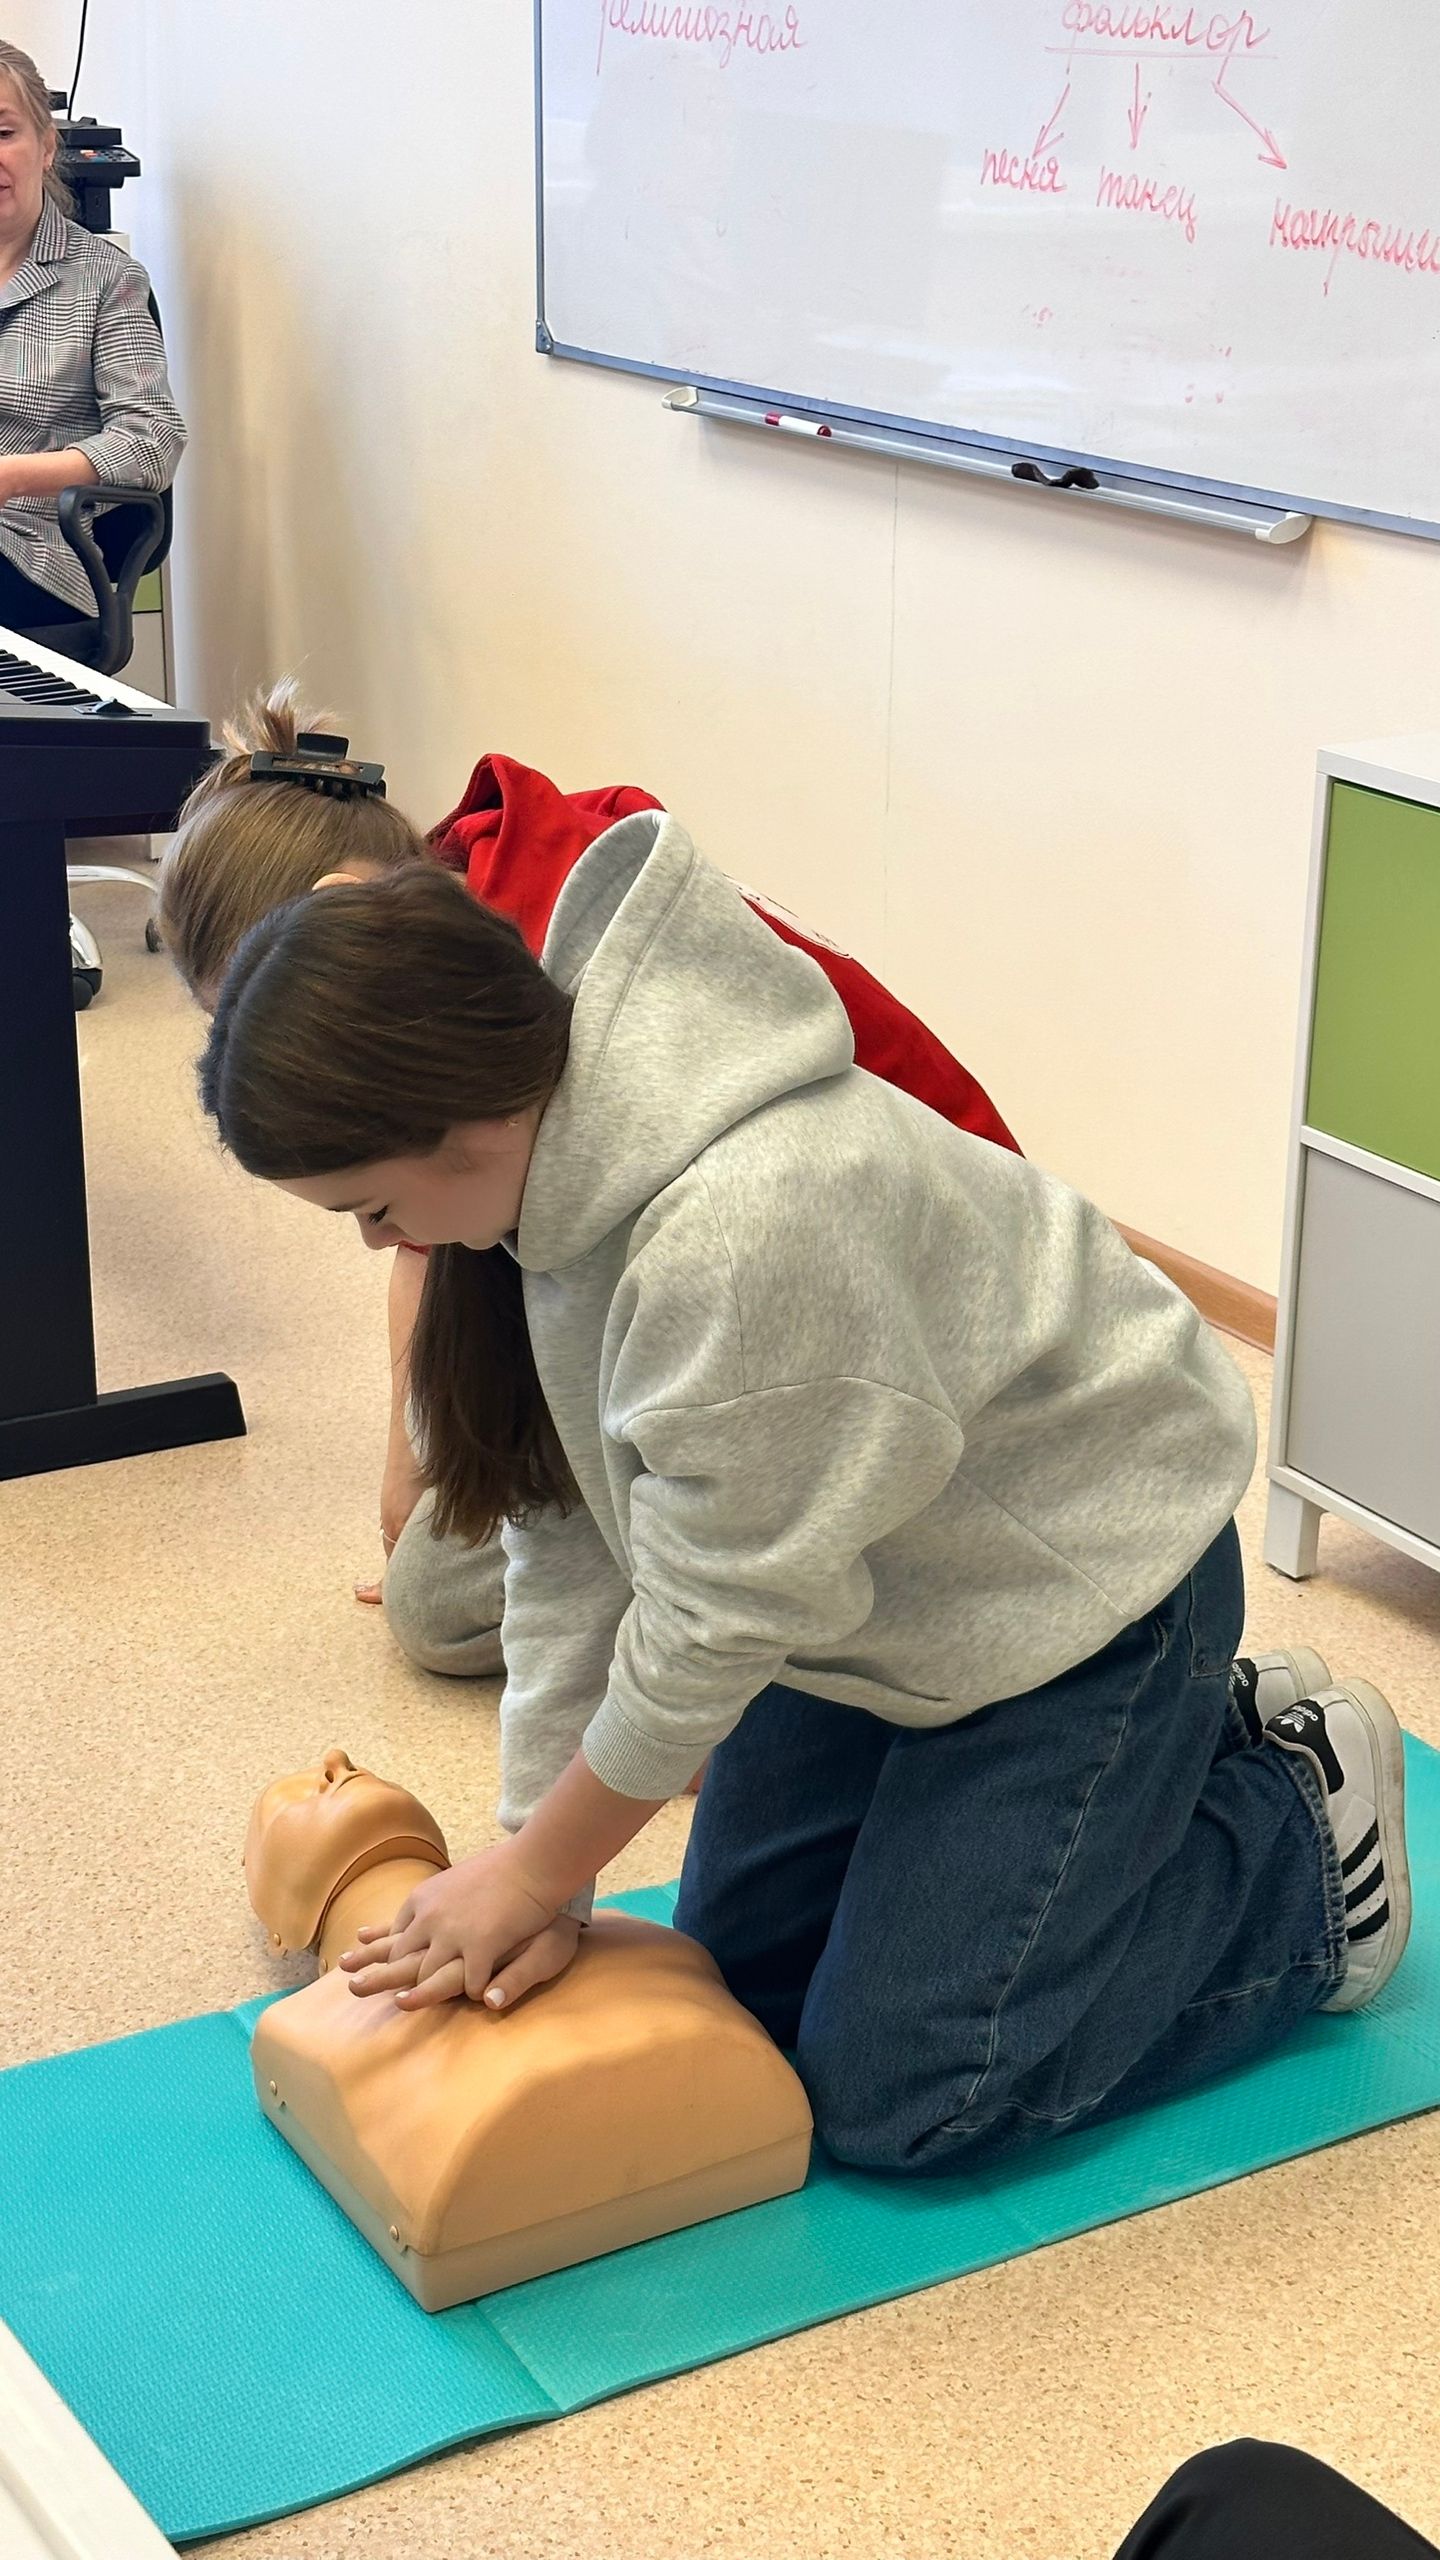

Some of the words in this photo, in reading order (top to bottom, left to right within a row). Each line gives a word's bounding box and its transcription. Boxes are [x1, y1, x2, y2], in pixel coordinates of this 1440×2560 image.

[980, 147, 1067, 192] песня
[1095, 165, 1198, 244] танец
[1231, 1661, 1249, 1687] adida
